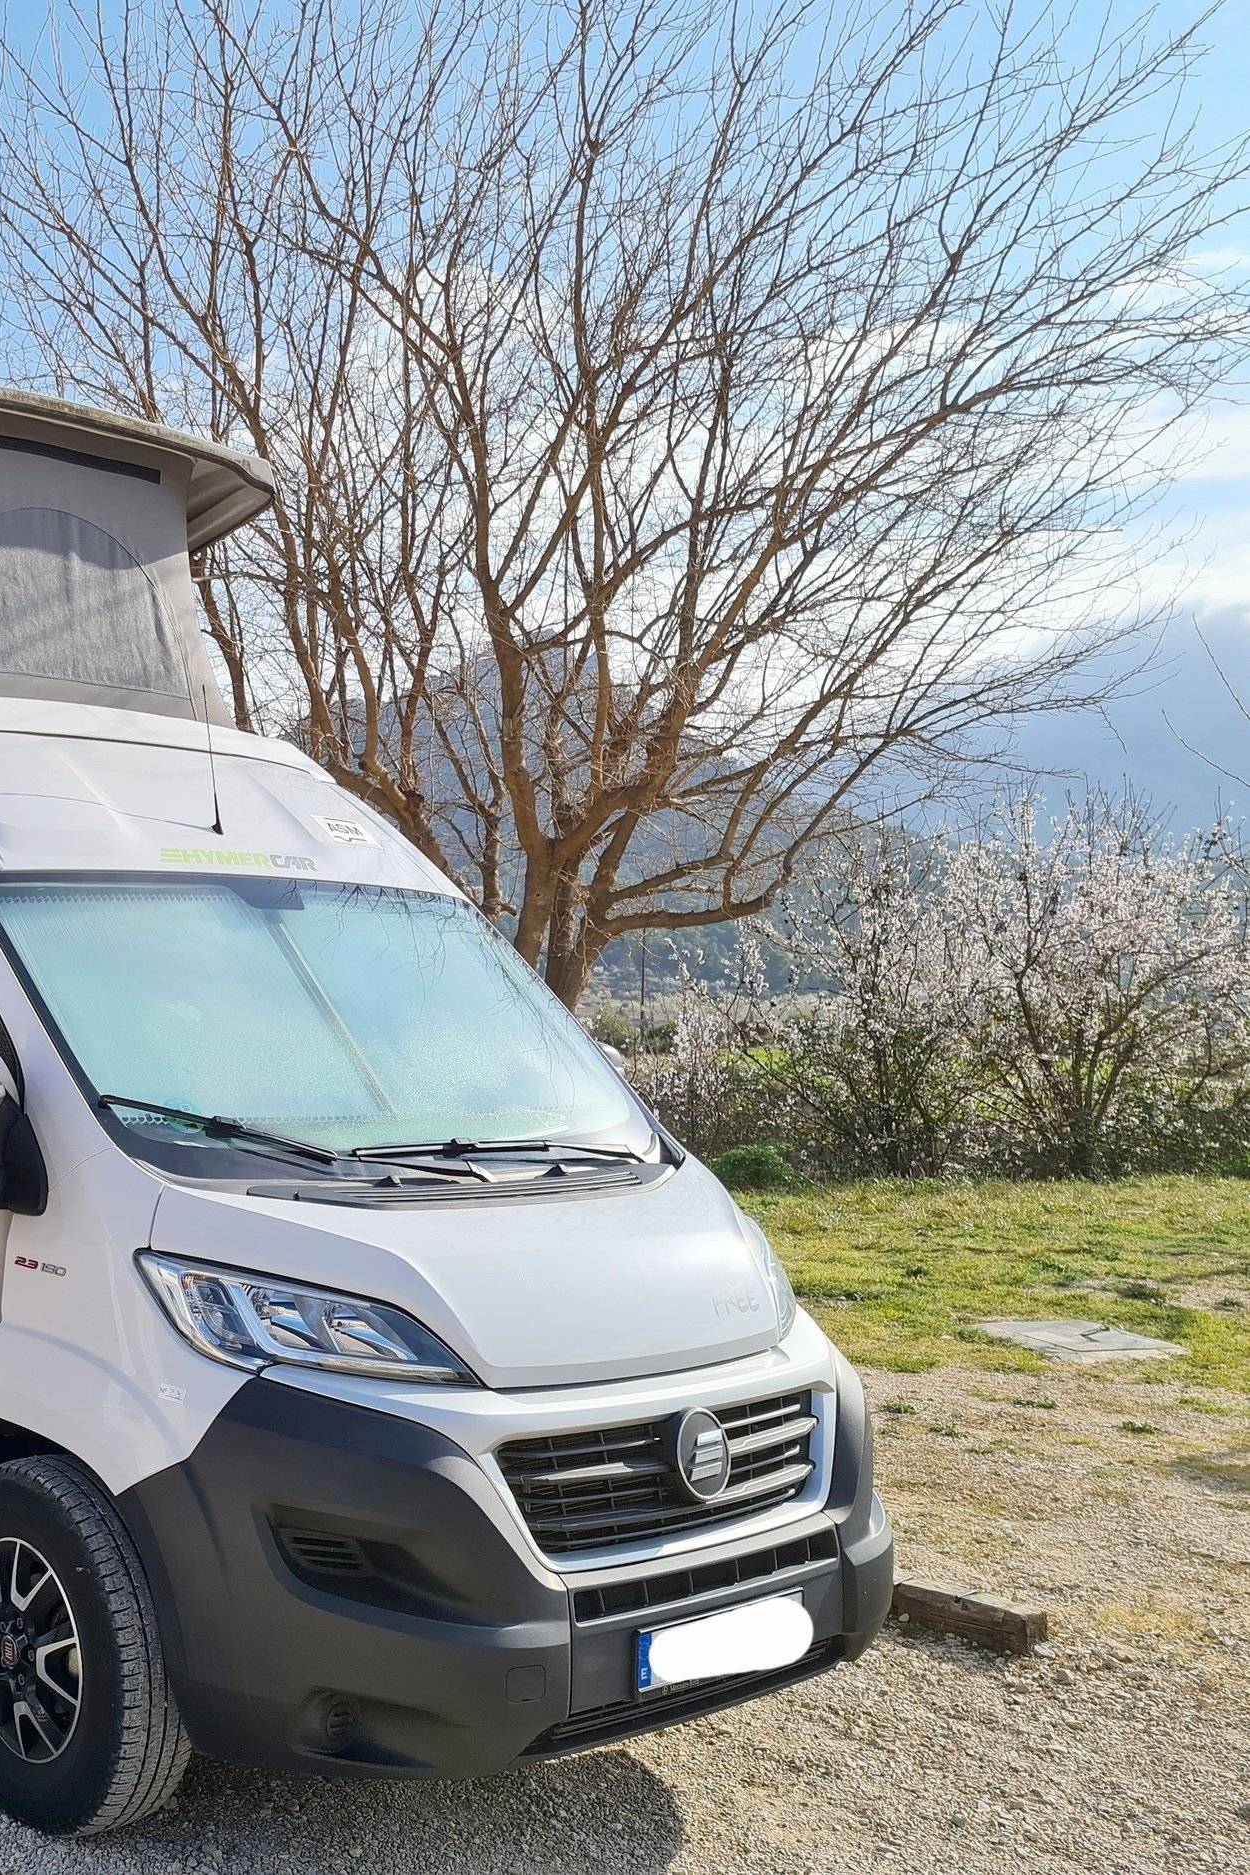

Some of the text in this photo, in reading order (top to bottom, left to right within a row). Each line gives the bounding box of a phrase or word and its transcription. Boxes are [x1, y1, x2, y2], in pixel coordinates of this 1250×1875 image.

[326, 822, 364, 837] ASM
[40, 1262, 67, 1277] 150
[640, 1667, 648, 1680] E
